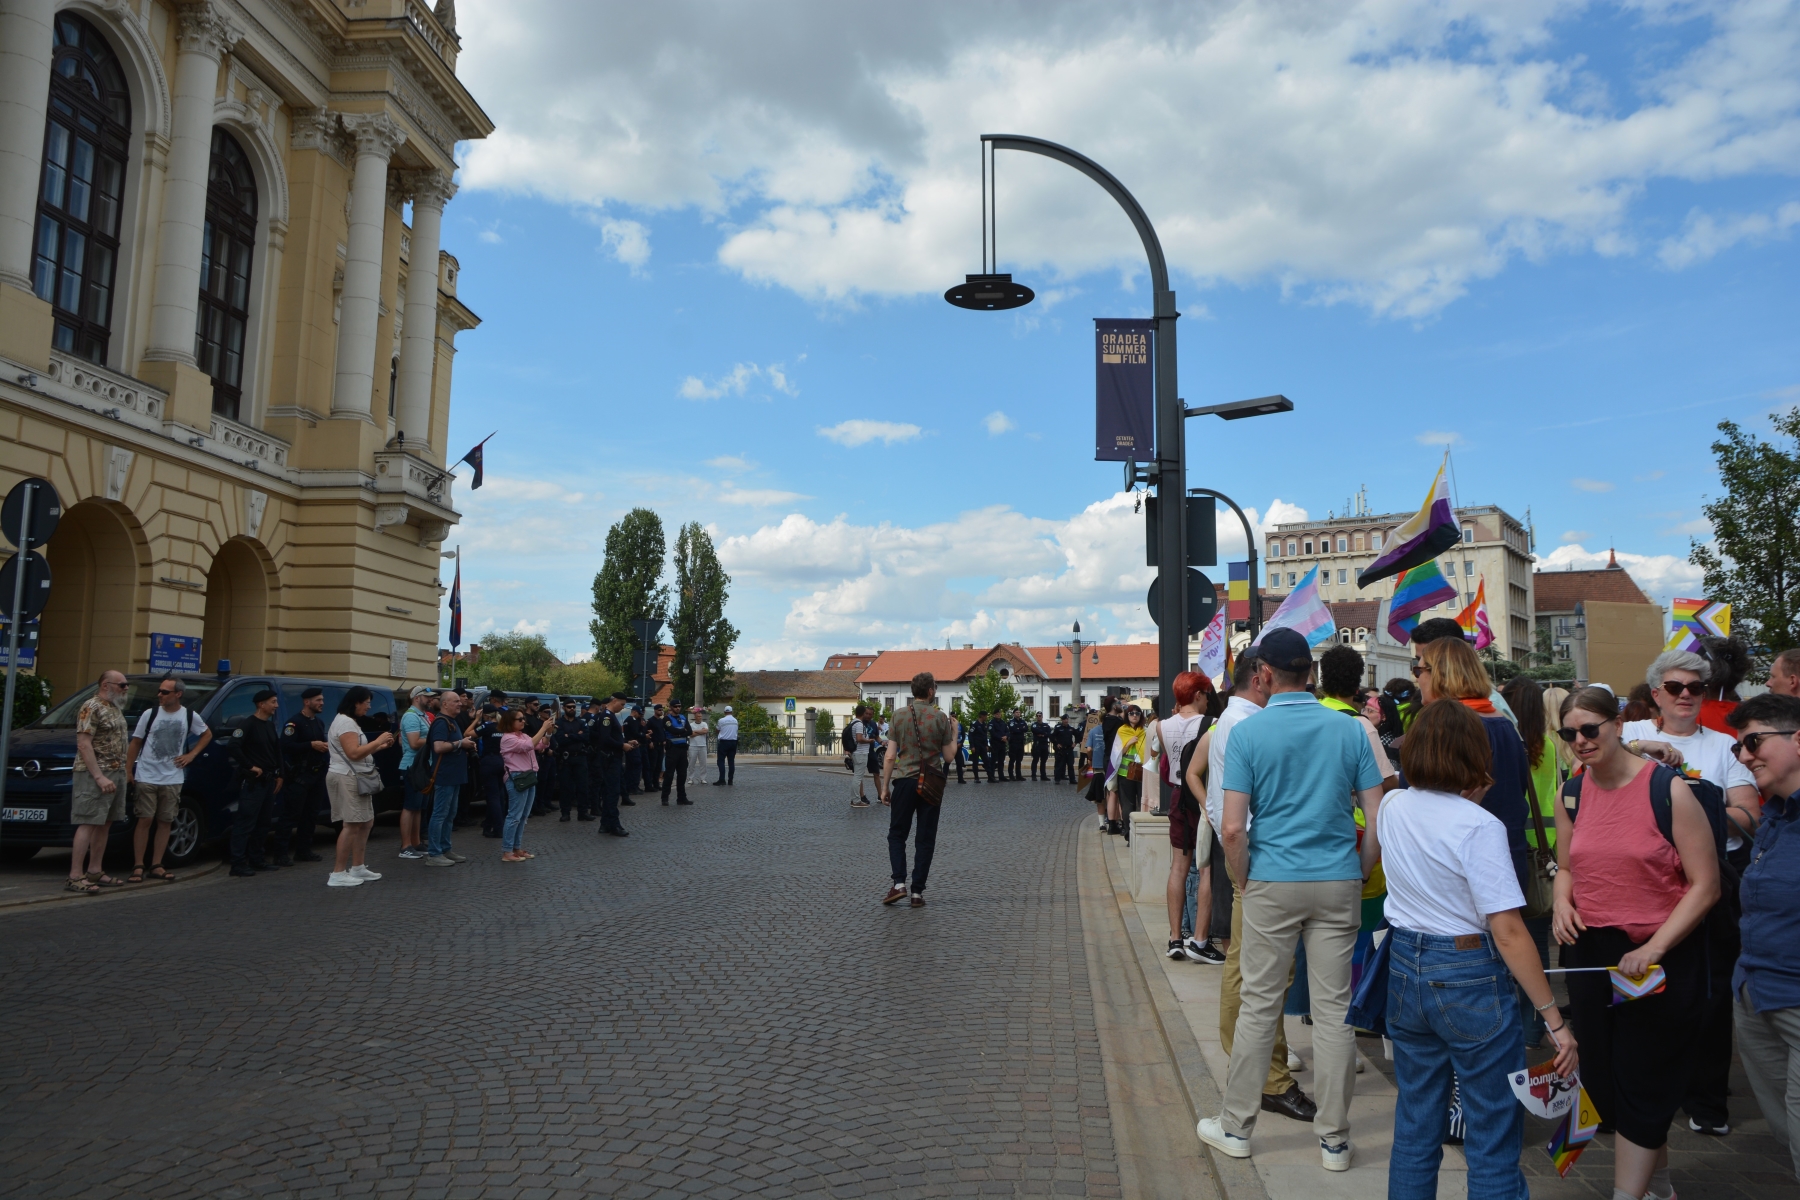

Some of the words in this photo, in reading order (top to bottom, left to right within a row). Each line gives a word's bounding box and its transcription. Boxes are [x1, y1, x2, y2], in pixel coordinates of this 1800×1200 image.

[1102, 334, 1146, 345] ORADEA
[1102, 345, 1146, 354] SUMMER
[1122, 354, 1146, 363] FILM
[19, 809, 45, 820] 51266
[1457, 937, 1478, 949] Lee
